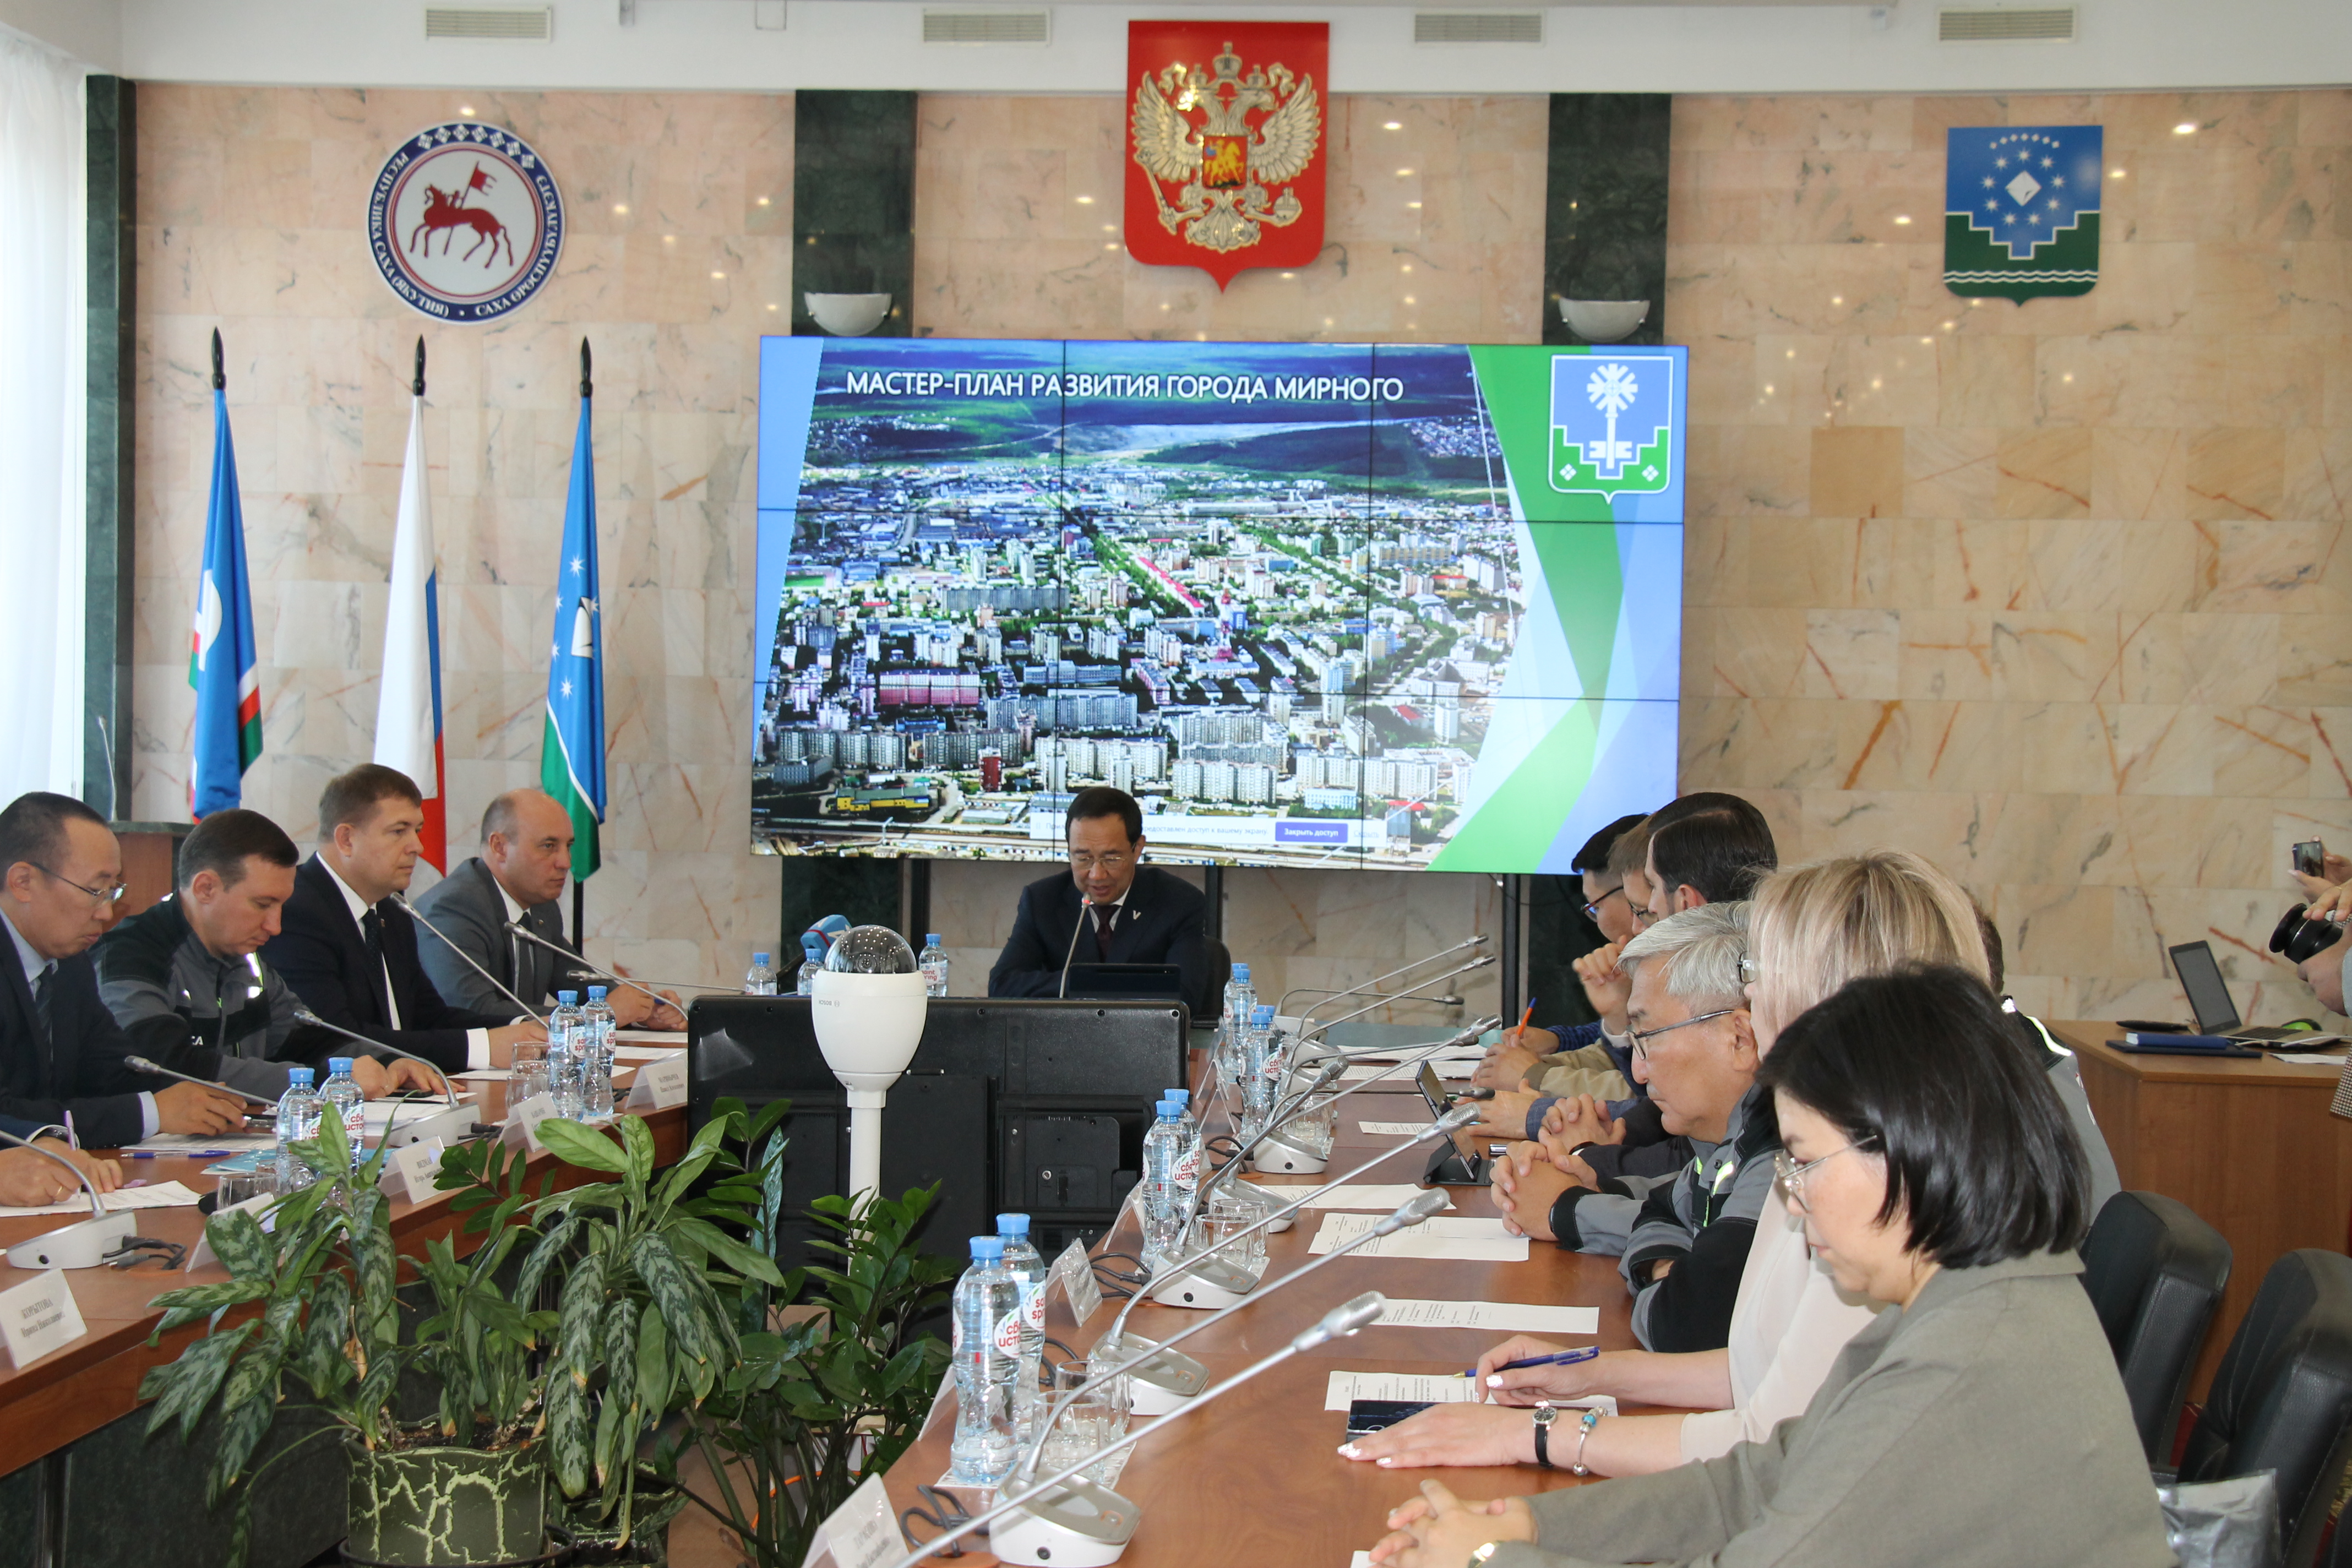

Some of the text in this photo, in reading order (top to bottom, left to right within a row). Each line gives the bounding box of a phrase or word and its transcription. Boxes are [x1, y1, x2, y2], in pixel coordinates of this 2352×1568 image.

[371, 151, 449, 318] РЕСПУБЛИКА САХА (ЯКУТИЯ)
[475, 298, 511, 317] САХА
[846, 371, 1404, 404] МАСТЕР-ПЛАН РАЗВИТИЯ ГОРОДА МИРНОГО
[1284, 827, 1314, 836] Закрыть
